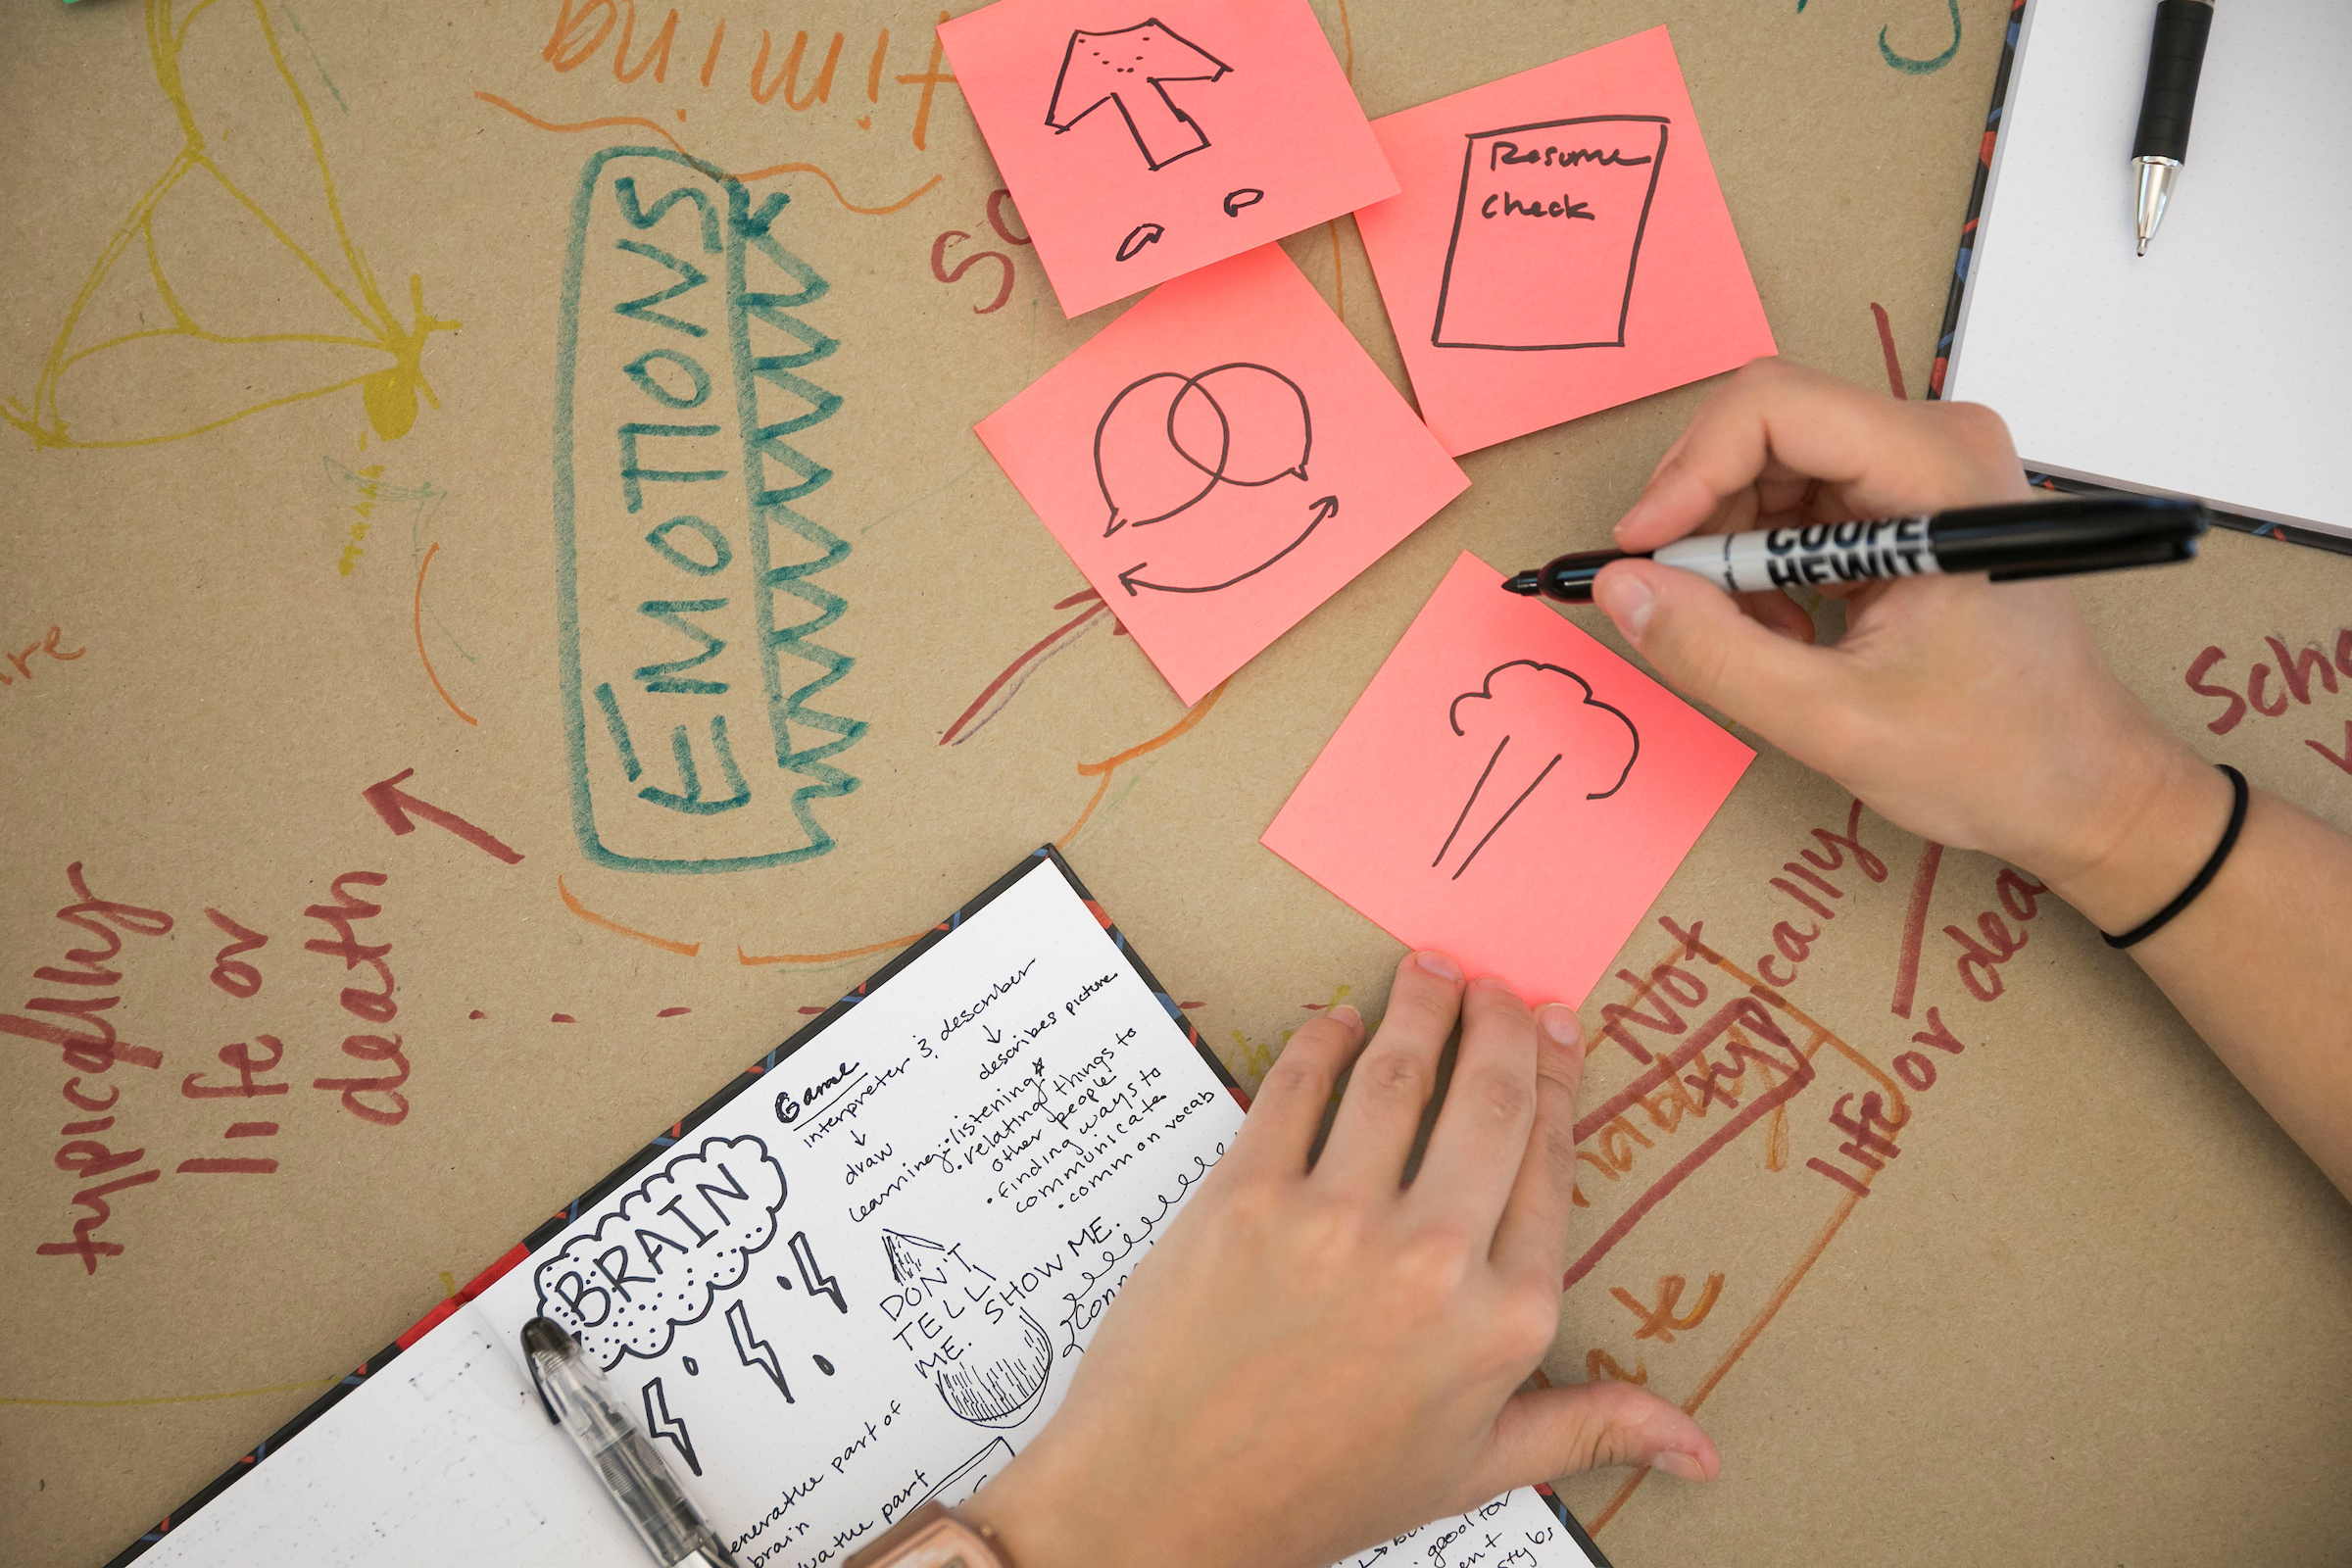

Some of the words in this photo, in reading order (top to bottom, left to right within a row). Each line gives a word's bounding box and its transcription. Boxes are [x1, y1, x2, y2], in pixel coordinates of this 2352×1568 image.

[1491, 140, 1652, 172] Resume
[592, 176, 752, 815] EMOTIONS
[203, 906, 269, 999] or
[304, 870, 412, 1126] death
[1599, 914, 1723, 1066] Not
[1685, 801, 1889, 1110] typically
[22, 861, 174, 1274] typically
[775, 1061, 860, 1124] Game
[846, 1143, 893, 1186] draw
[979, 1010, 1057, 1080] describes
[963, 1101, 1057, 1165] relating
[1053, 1048, 1114, 1097] things
[1115, 1027, 1137, 1047] to
[1806, 1090, 1911, 1198] life
[1891, 1005, 1966, 1093] or
[1942, 867, 2049, 1003] dea
[175, 1034, 289, 1174] life
[803, 1057, 910, 1149] interpreter
[992, 1128, 1042, 1172] other
[1054, 1074, 1117, 1130] people
[998, 1138, 1085, 1199] finding
[1079, 1082, 1138, 1135] ways
[1139, 1067, 1161, 1087] to
[1015, 1094, 1167, 1213] communicate
[1164, 1091, 1215, 1130] vocab
[554, 1162, 749, 1329] BRAIN
[879, 1242, 972, 1322] DON'T
[914, 1335, 973, 1379] ME.
[984, 1253, 1064, 1325] SHOW
[1067, 1215, 1121, 1257] ME.
[830, 1421, 878, 1474] part
[884, 1399, 902, 1427] of
[881, 1468, 929, 1525] part
